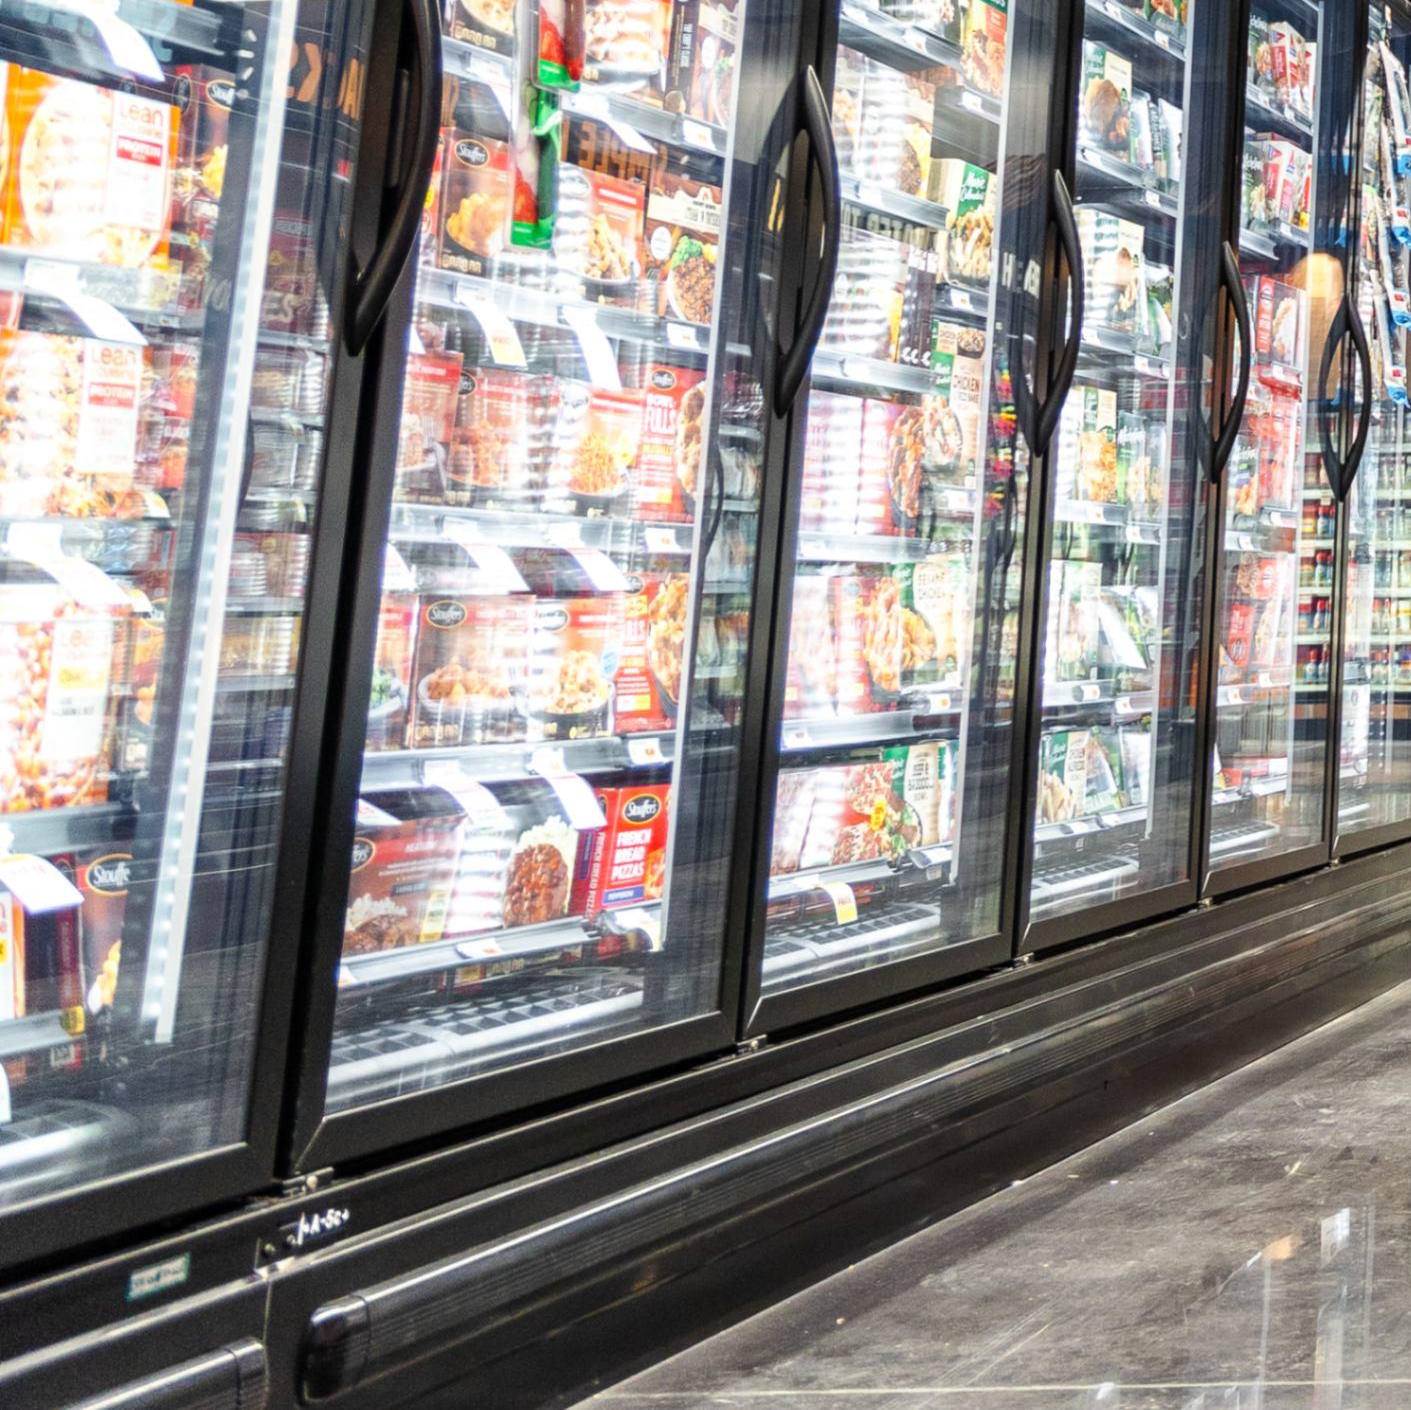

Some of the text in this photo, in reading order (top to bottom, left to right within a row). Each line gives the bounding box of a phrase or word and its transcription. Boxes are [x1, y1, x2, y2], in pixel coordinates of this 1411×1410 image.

[120, 101, 164, 128] Lean
[91, 347, 136, 367] Lean
[89, 385, 135, 399] PROTEIN
